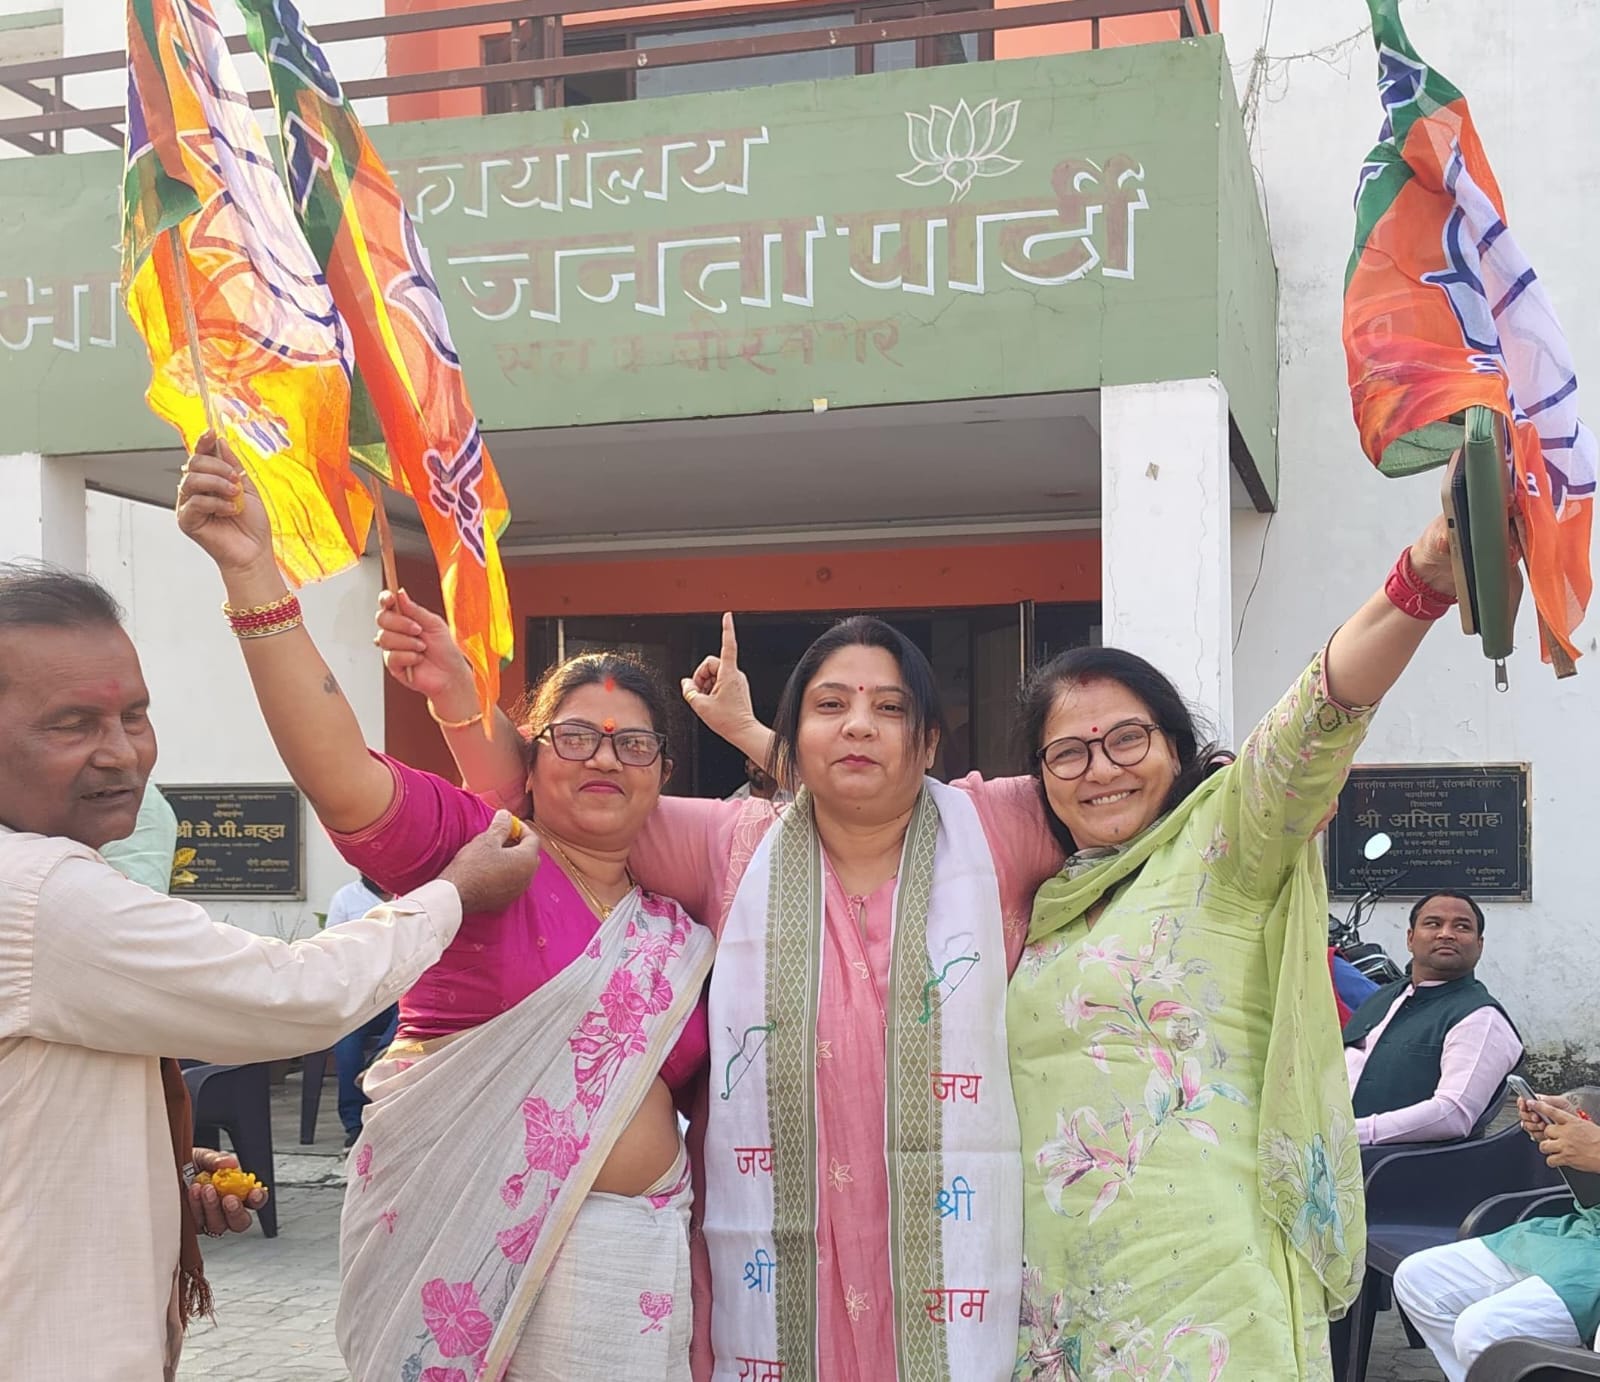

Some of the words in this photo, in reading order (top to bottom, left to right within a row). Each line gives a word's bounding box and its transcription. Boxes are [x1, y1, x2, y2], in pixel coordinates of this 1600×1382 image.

[446, 214, 827, 323] जनता
[832, 152, 1150, 296] पार्टी
[1354, 809, 1382, 829] श्री
[1389, 809, 1452, 828] अमित
[1459, 812, 1502, 828] शाह
[931, 1072, 983, 1104] जय
[734, 1147, 776, 1178] जय
[933, 1175, 977, 1222] श्री
[743, 1248, 776, 1293] श्री
[922, 1288, 990, 1323] राम
